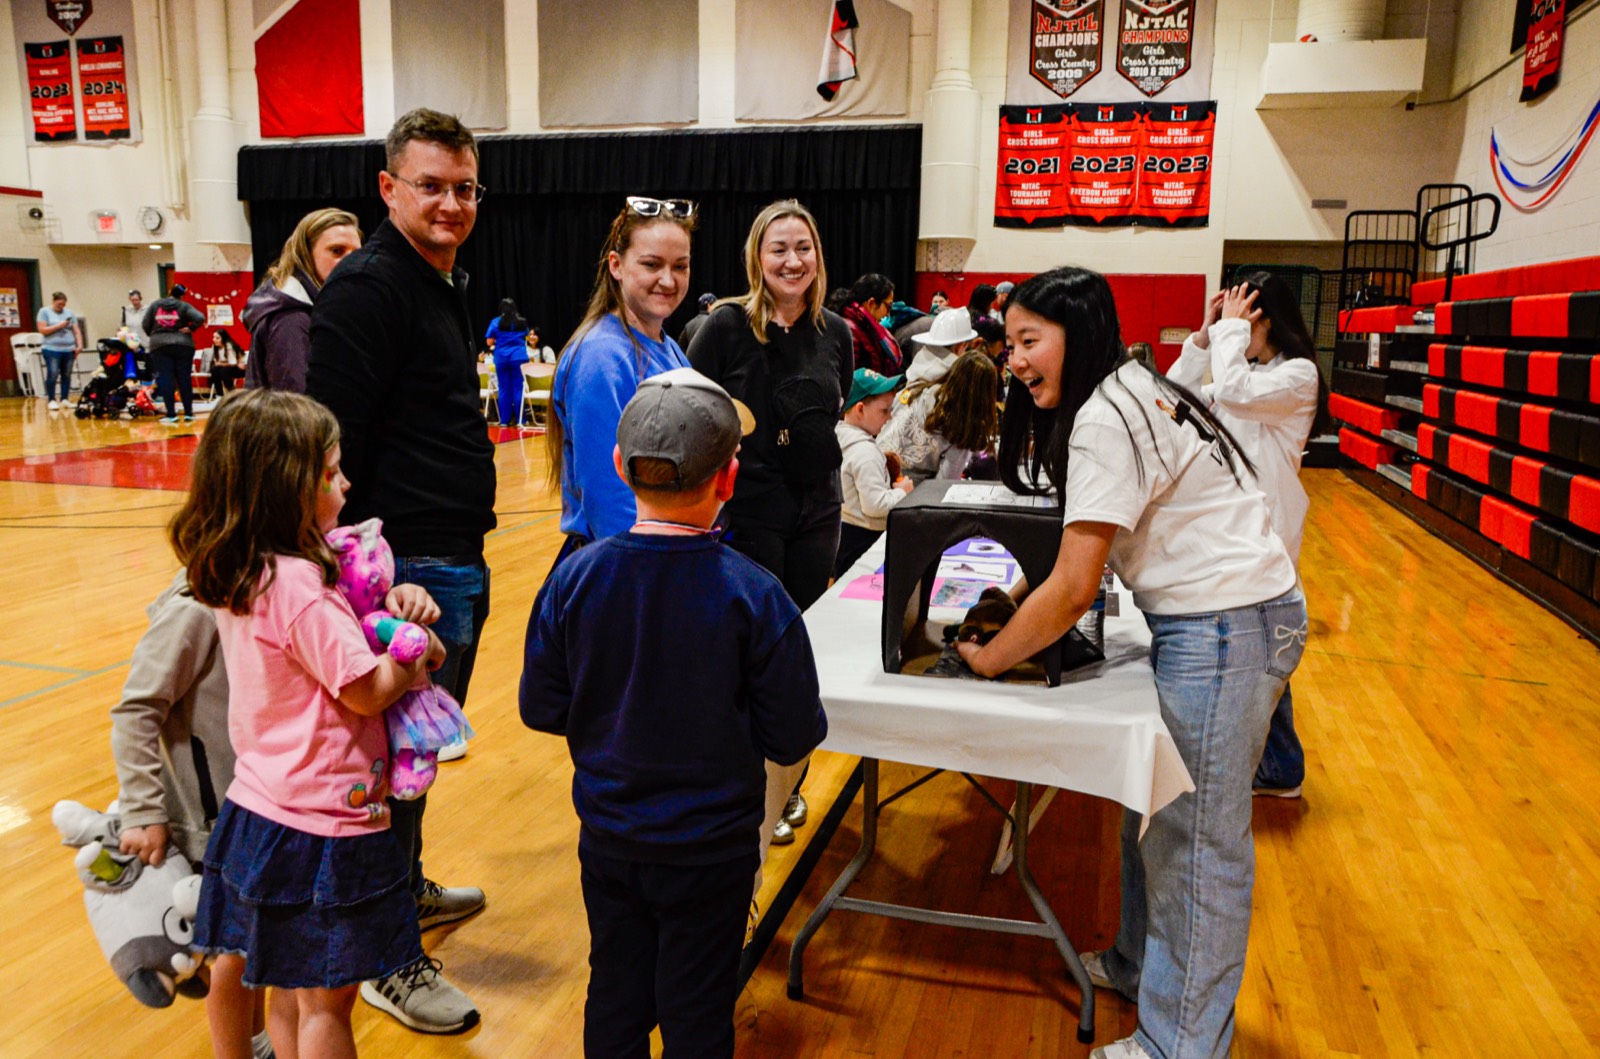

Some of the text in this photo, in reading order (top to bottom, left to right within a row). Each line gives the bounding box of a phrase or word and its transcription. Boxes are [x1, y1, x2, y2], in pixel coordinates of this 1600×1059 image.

[1037, 12, 1098, 33] NJTIL
[1124, 7, 1189, 30] NJTAC
[1035, 32, 1099, 48] CHAMPIONS
[1122, 29, 1189, 44] CHAMPIONS
[1055, 48, 1077, 59] Girls
[1142, 45, 1165, 56] Girls
[1035, 58, 1097, 72] Cross Country
[1122, 56, 1186, 69] Cross Country
[1047, 69, 1083, 79] 2009
[1129, 67, 1149, 77] 2010
[1158, 66, 1176, 76] 2011
[31, 82, 70, 99] 2023
[83, 81, 125, 96] 2024
[1023, 129, 1043, 138] GIRLS
[1094, 128, 1115, 137] GIRLS
[1167, 127, 1189, 137] GIRLS
[1007, 137, 1059, 146] CROSS COUNTRY
[1077, 135, 1132, 144] CROSS COUNTRY
[1150, 135, 1205, 144] CROSS COUNTRY
[1004, 156, 1060, 175] 2021
[1070, 154, 1136, 174] 2023
[1143, 154, 1210, 174] 2023
[1021, 182, 1041, 190] NJTAC
[1163, 181, 1184, 189] NJTAC
[1009, 190, 1052, 198] TOURNAMENT
[1070, 187, 1131, 196] FREEDOM DIVISION
[1151, 188, 1196, 197] TOURNAMENT
[1011, 197, 1049, 206] CHAMPIONS
[1080, 196, 1120, 205] CHAMPIONS
[1153, 196, 1193, 205] CHAMPIONS
